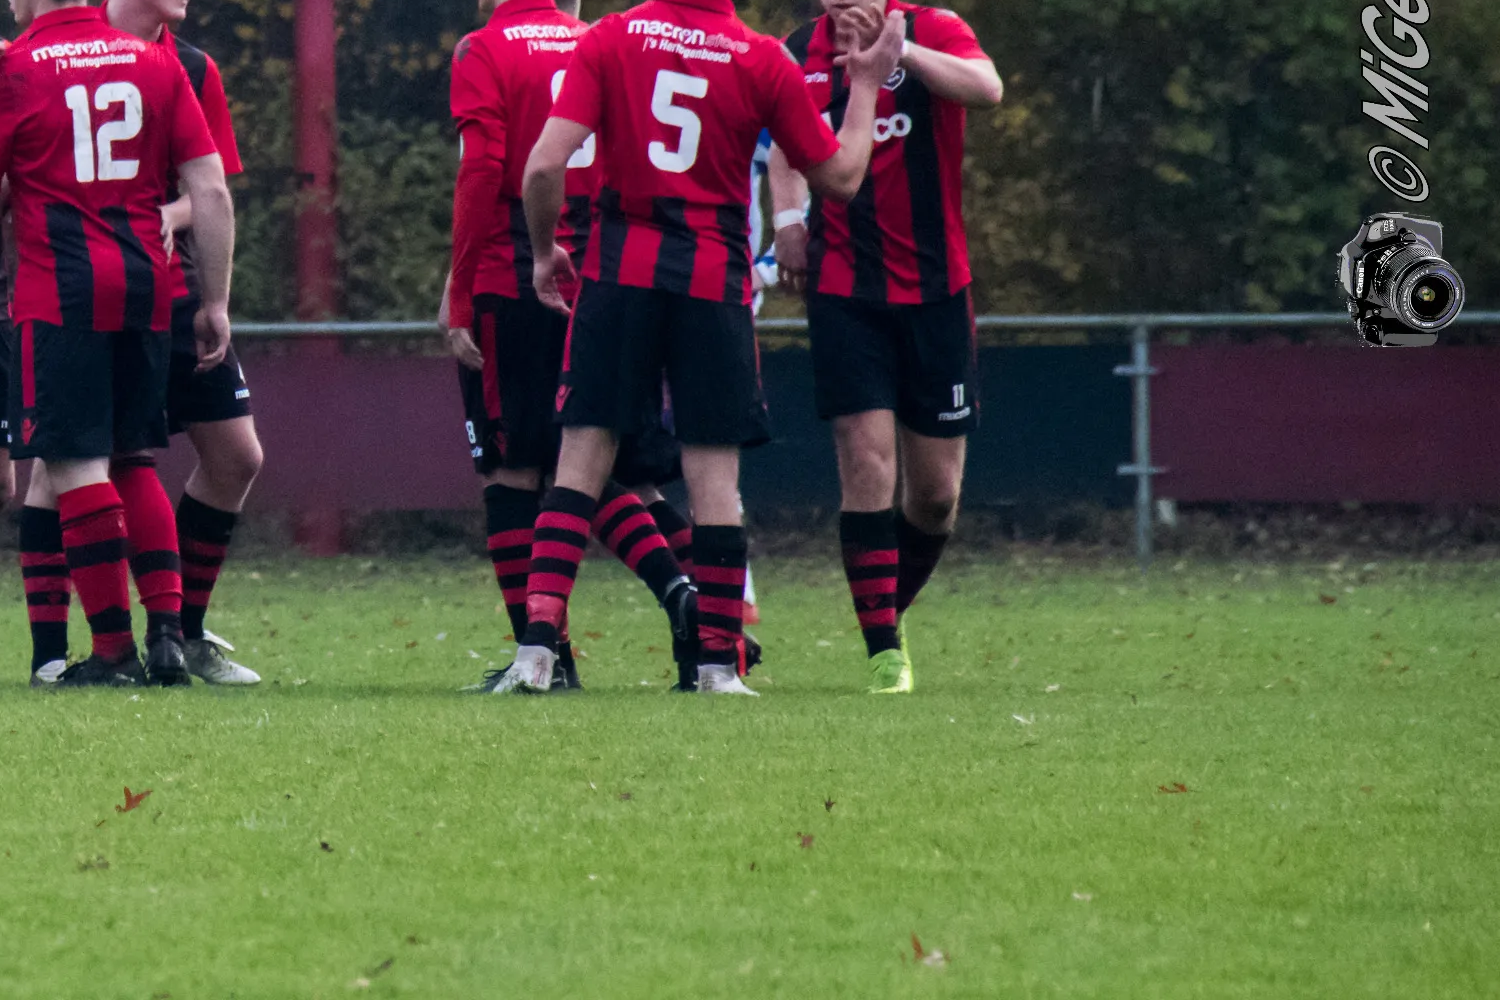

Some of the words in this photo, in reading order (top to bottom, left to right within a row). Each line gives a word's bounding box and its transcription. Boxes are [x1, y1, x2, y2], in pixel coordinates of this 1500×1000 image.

[65, 82, 143, 183] 12
[648, 69, 708, 173] 5
[952, 383, 964, 408] 11
[465, 420, 476, 444] 8
